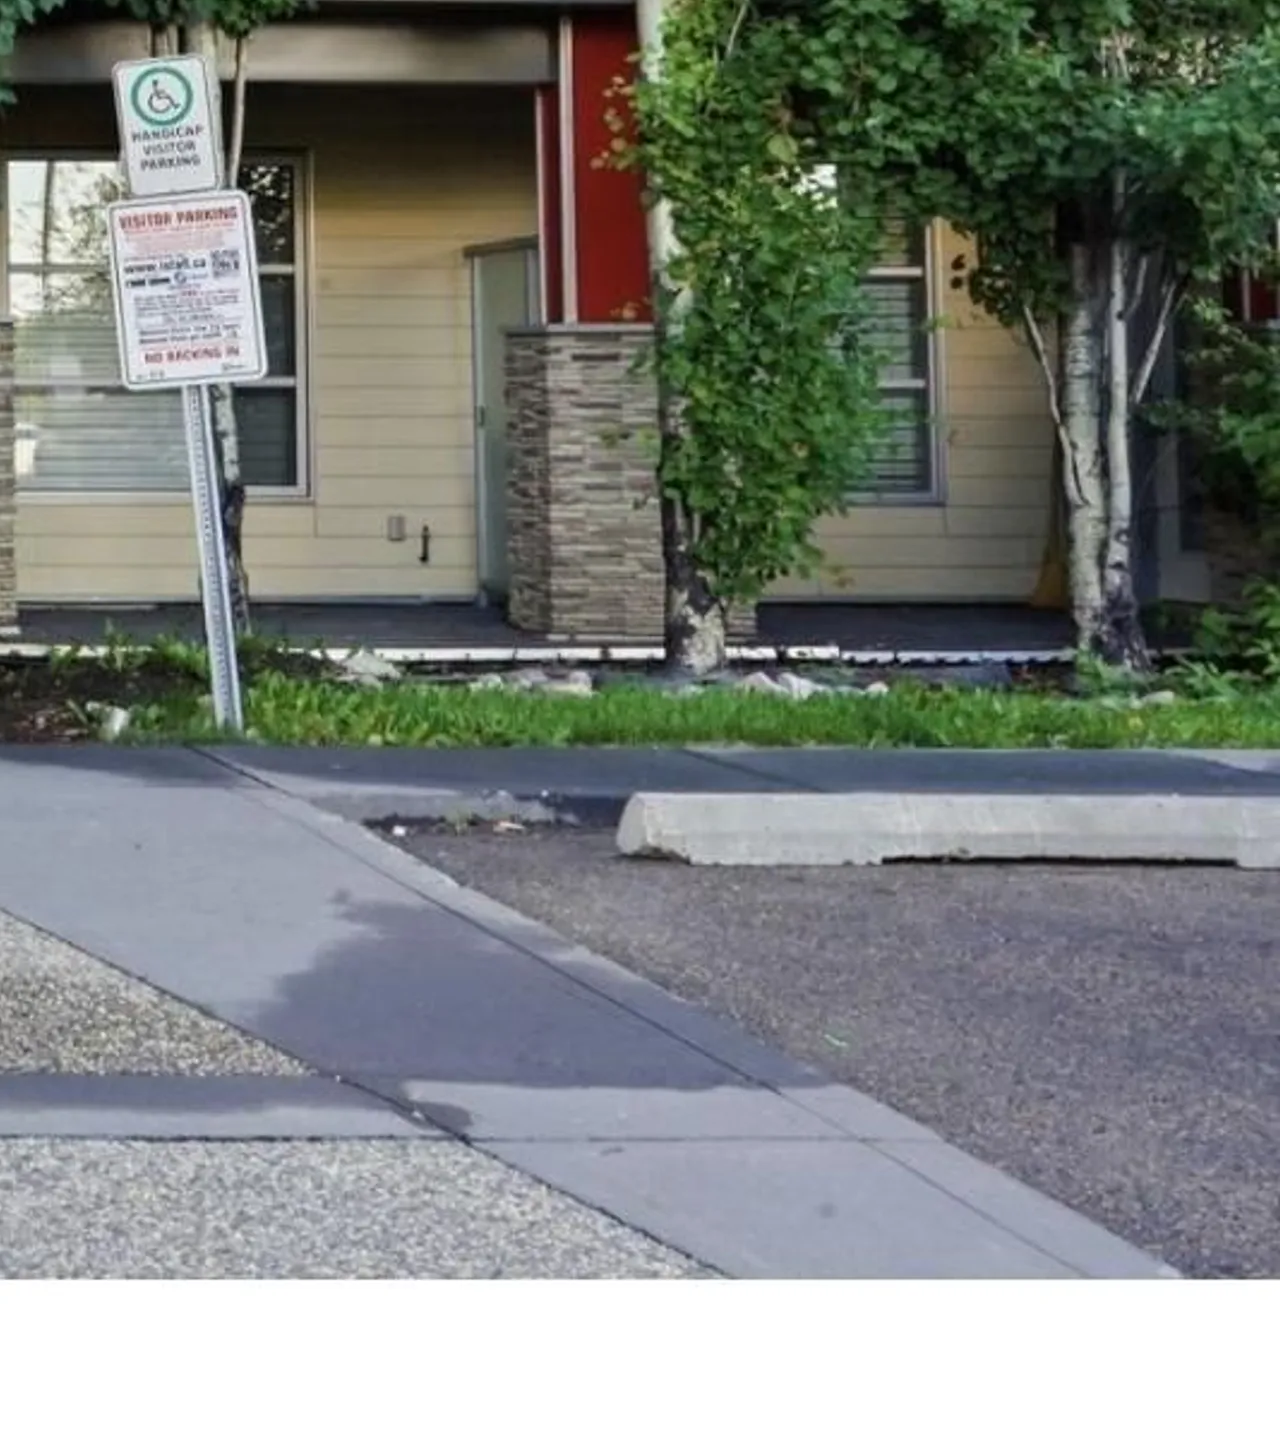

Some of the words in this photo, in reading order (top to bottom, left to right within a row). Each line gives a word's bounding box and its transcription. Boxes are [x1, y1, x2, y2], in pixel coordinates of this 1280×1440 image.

[132, 124, 204, 142] HANDICAP
[142, 139, 197, 156] VISITOR
[140, 154, 201, 170] PARKING
[119, 211, 172, 230] VISITOR
[177, 205, 237, 224] PARKING
